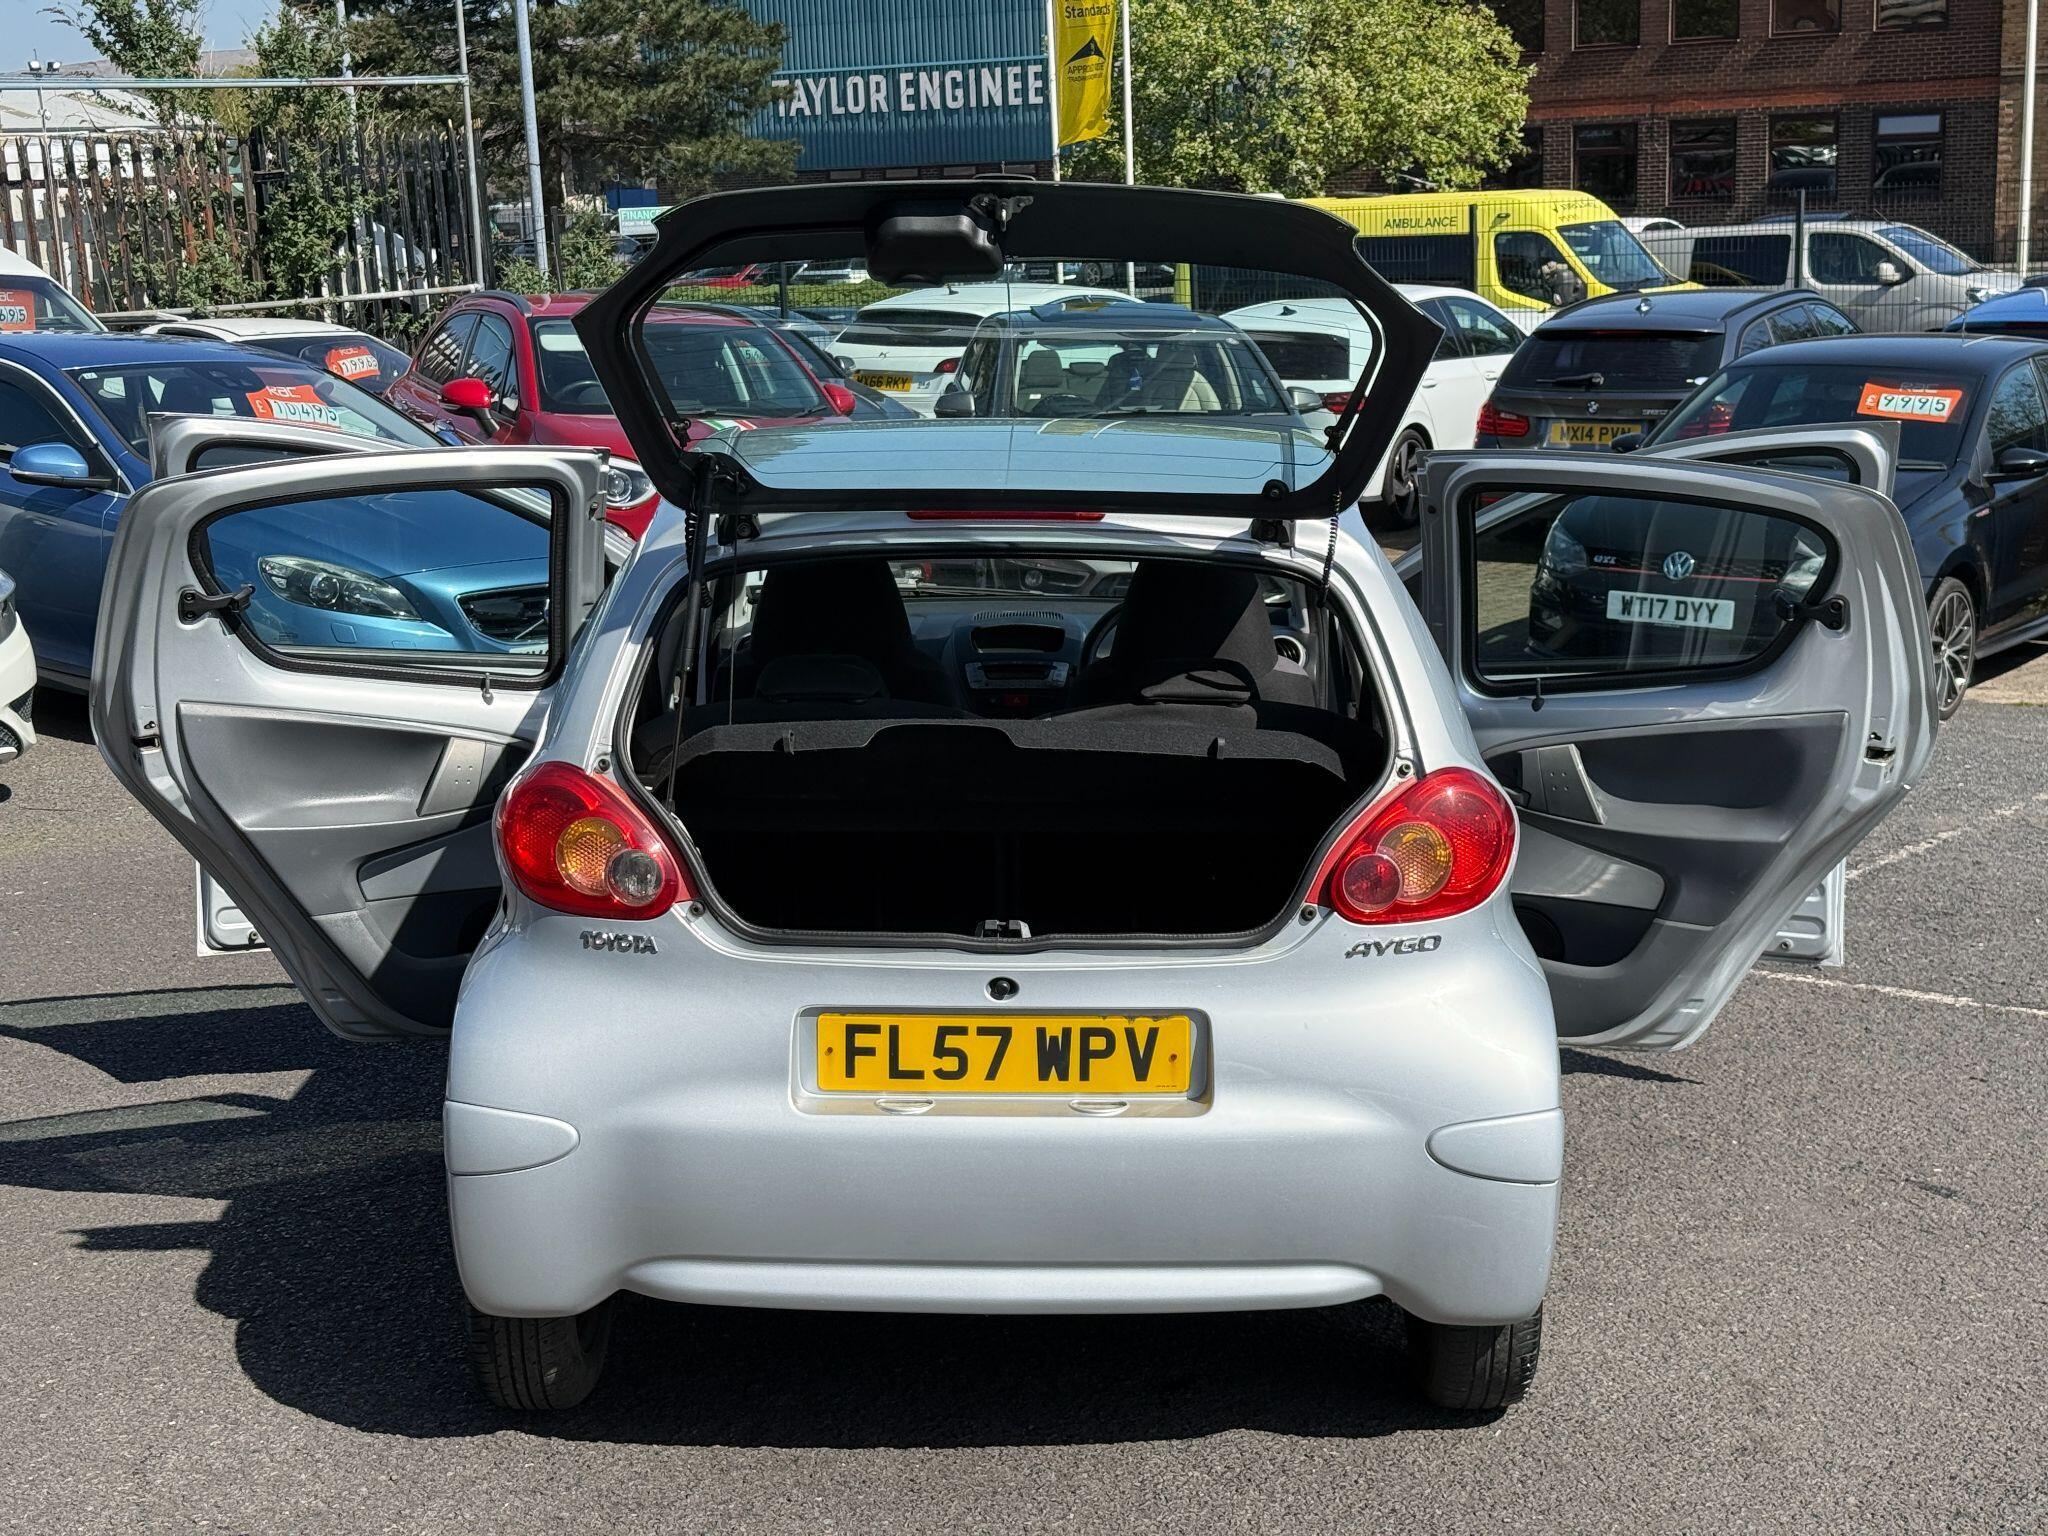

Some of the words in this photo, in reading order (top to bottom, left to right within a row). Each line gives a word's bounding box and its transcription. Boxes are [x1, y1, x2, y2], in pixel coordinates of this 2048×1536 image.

[771, 74, 890, 118] TAYLOR
[900, 65, 1044, 112] ENGINEE
[1384, 216, 1458, 229] AMBULANCE
[884, 375, 910, 390] RKY
[273, 400, 337, 421] 10495
[1883, 394, 1946, 413] 9995
[1621, 594, 1669, 619] WT17
[1675, 599, 1719, 624] DYY
[580, 930, 659, 955] TOYOTA
[1344, 933, 1442, 959] AYGO
[844, 1023, 1013, 1082] FL57
[1035, 1026, 1160, 1083] WPV
